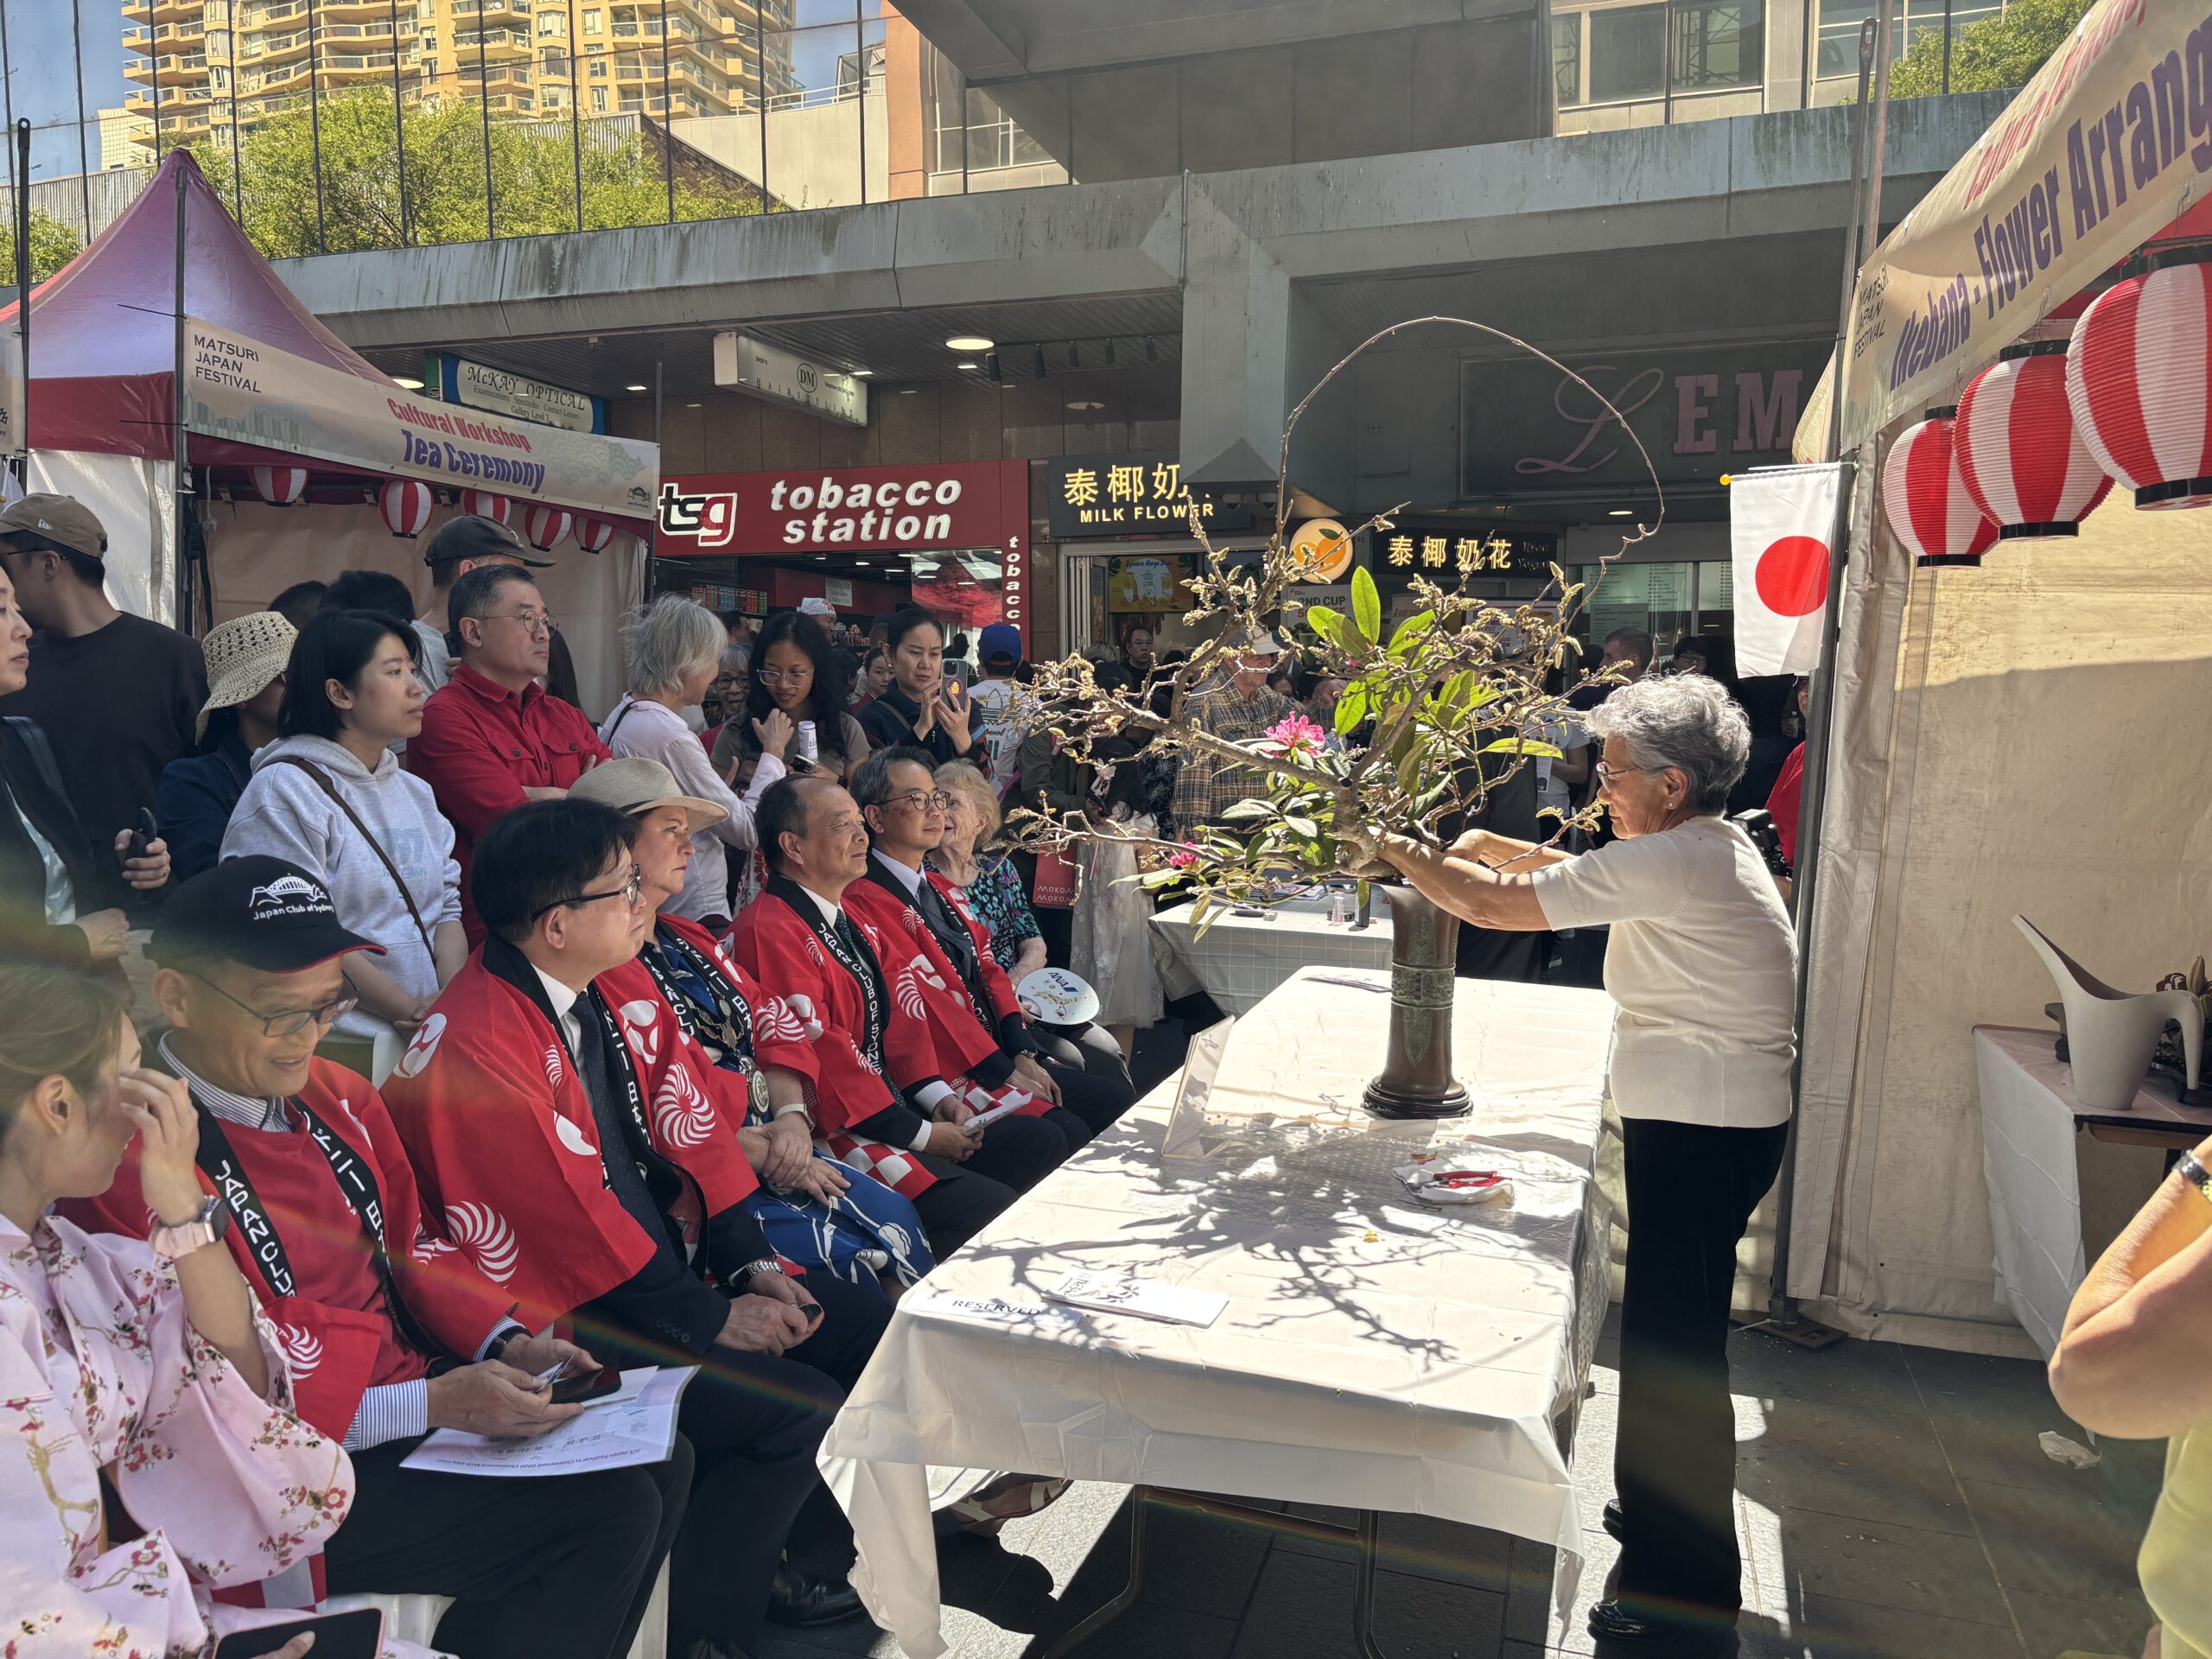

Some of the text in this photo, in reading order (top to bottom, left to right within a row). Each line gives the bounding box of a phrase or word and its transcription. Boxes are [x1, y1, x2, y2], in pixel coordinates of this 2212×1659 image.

[1974, 163, 2063, 320] Flower
[1857, 299, 1885, 335] JAPAN
[194, 334, 259, 362] MATSURI
[1853, 318, 1887, 362] FESTIVAL
[195, 351, 243, 372] JAPAN
[195, 365, 261, 393] FESTIVAL
[799, 369, 814, 388] DM
[467, 366, 518, 395] McKAY
[526, 383, 586, 410] OPTICAL
[387, 397, 532, 454] Cultural Workshop
[511, 405, 530, 419] Gallery
[531, 410, 544, 421] Level
[401, 429, 545, 494] Tea Ceremony
[770, 477, 962, 512] tobacco
[1064, 462, 1210, 507] 泰椰奶
[658, 482, 738, 547] tsg
[782, 507, 951, 544] station
[1080, 503, 1214, 523] MILK FLOWER
[1388, 535, 1512, 570] 泰椰奶花
[1006, 536, 1021, 631] tobacc
[1323, 595, 1345, 606] CUP
[253, 907, 285, 920] Japan
[286, 904, 305, 913] Club
[314, 904, 334, 913] Sydney
[818, 922, 853, 964] JAPAN
[852, 963, 875, 1000] CLUB
[869, 1001, 879, 1022] OF
[1048, 972, 1069, 988] ANA
[215, 1160, 270, 1244] JAPAN
[952, 1300, 1041, 1315] RESERVED
